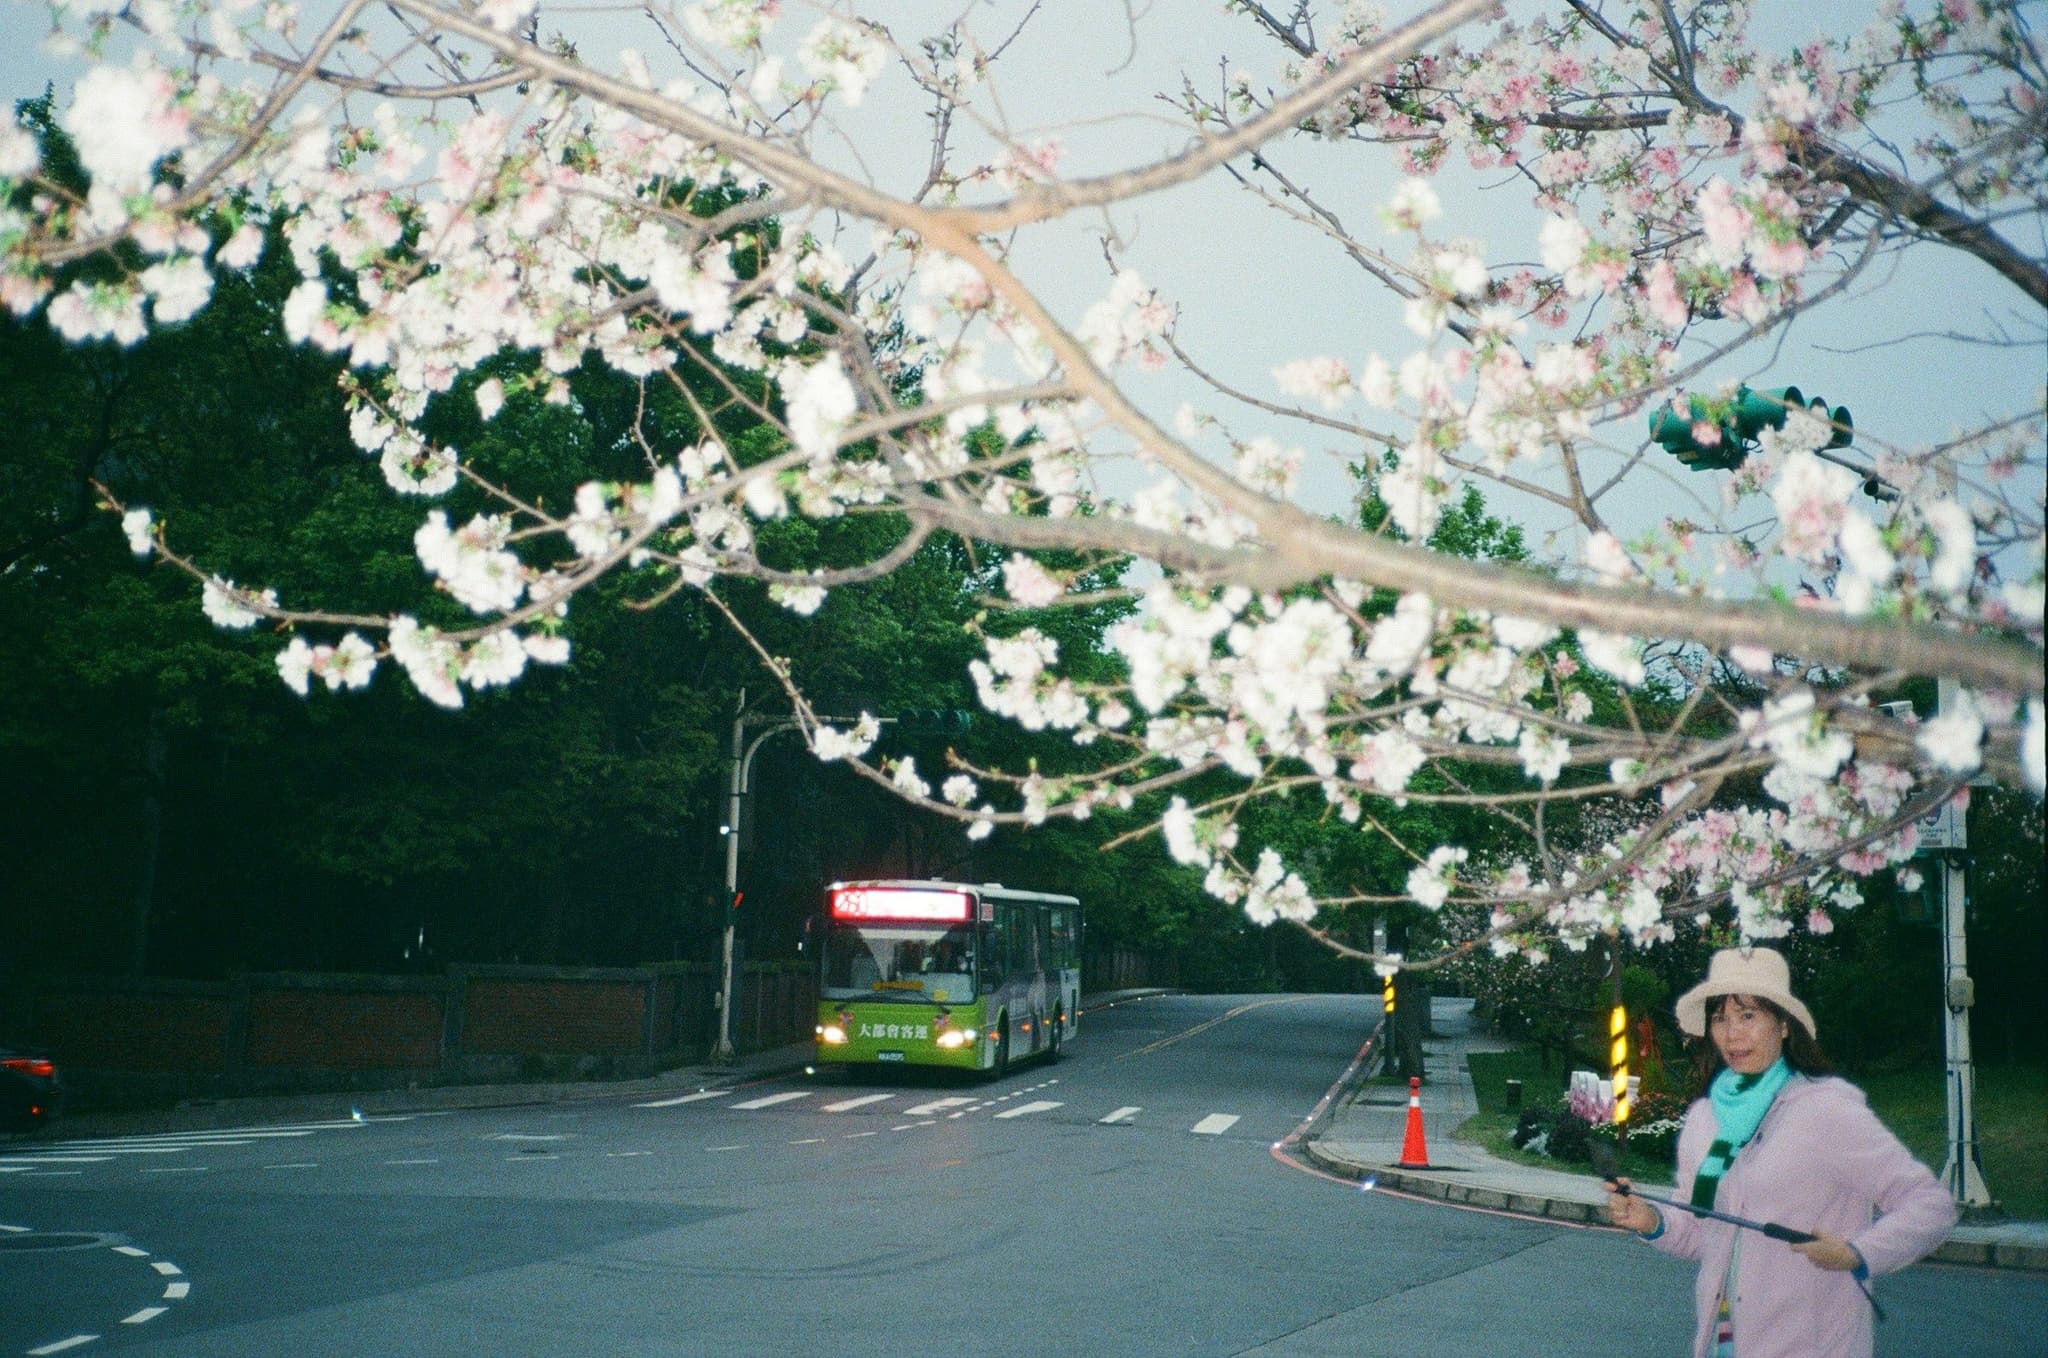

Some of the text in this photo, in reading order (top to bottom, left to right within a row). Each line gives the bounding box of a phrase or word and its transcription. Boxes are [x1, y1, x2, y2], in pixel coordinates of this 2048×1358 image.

[859, 1023, 928, 1039] 大都會客運
